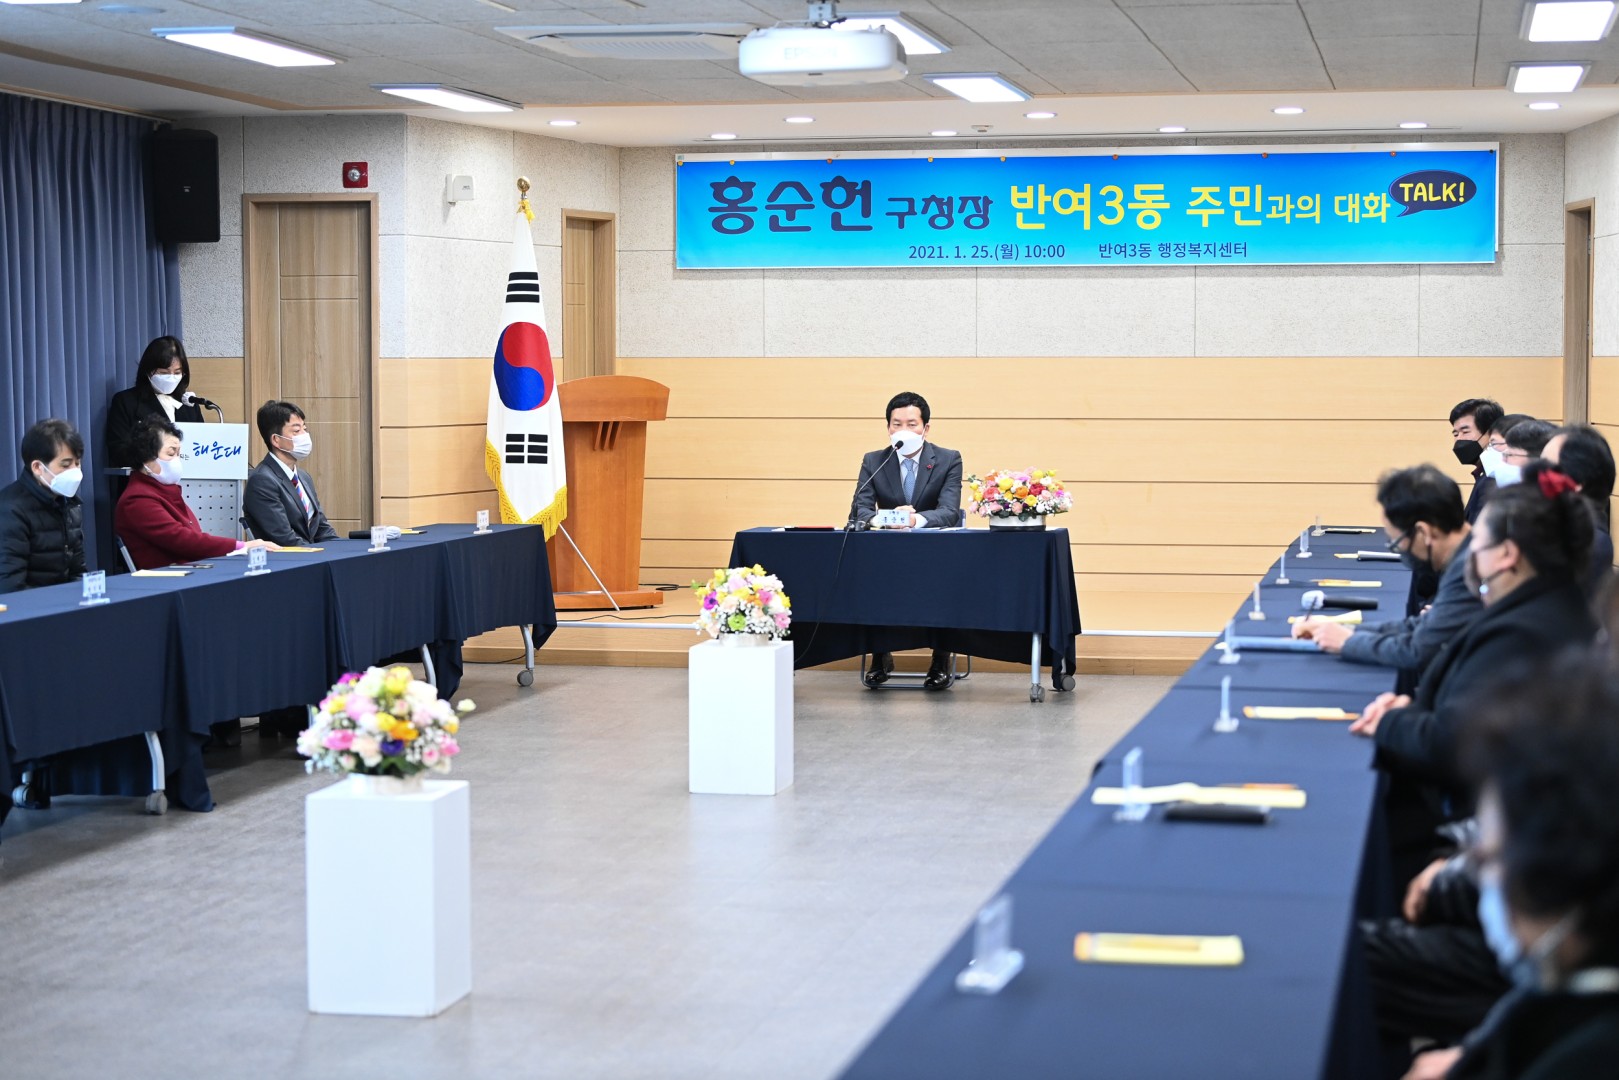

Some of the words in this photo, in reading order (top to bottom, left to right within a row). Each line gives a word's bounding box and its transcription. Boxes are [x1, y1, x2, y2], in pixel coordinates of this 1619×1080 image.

[1399, 181, 1465, 203] TALK!
[708, 175, 873, 235] 홍순헌
[885, 194, 994, 230] 구청장
[1011, 183, 1171, 231] 반여3동
[1186, 184, 1321, 227] 주민과의
[1334, 193, 1391, 223] 대화
[908, 245, 949, 259] 2021.
[954, 246, 967, 259] 1.
[972, 243, 1019, 261] 25.(월)
[1025, 244, 1066, 258] 10:00
[1099, 242, 1153, 259] 반여3동
[1158, 241, 1248, 259] 행정복지센터
[192, 440, 242, 461] 해운대
